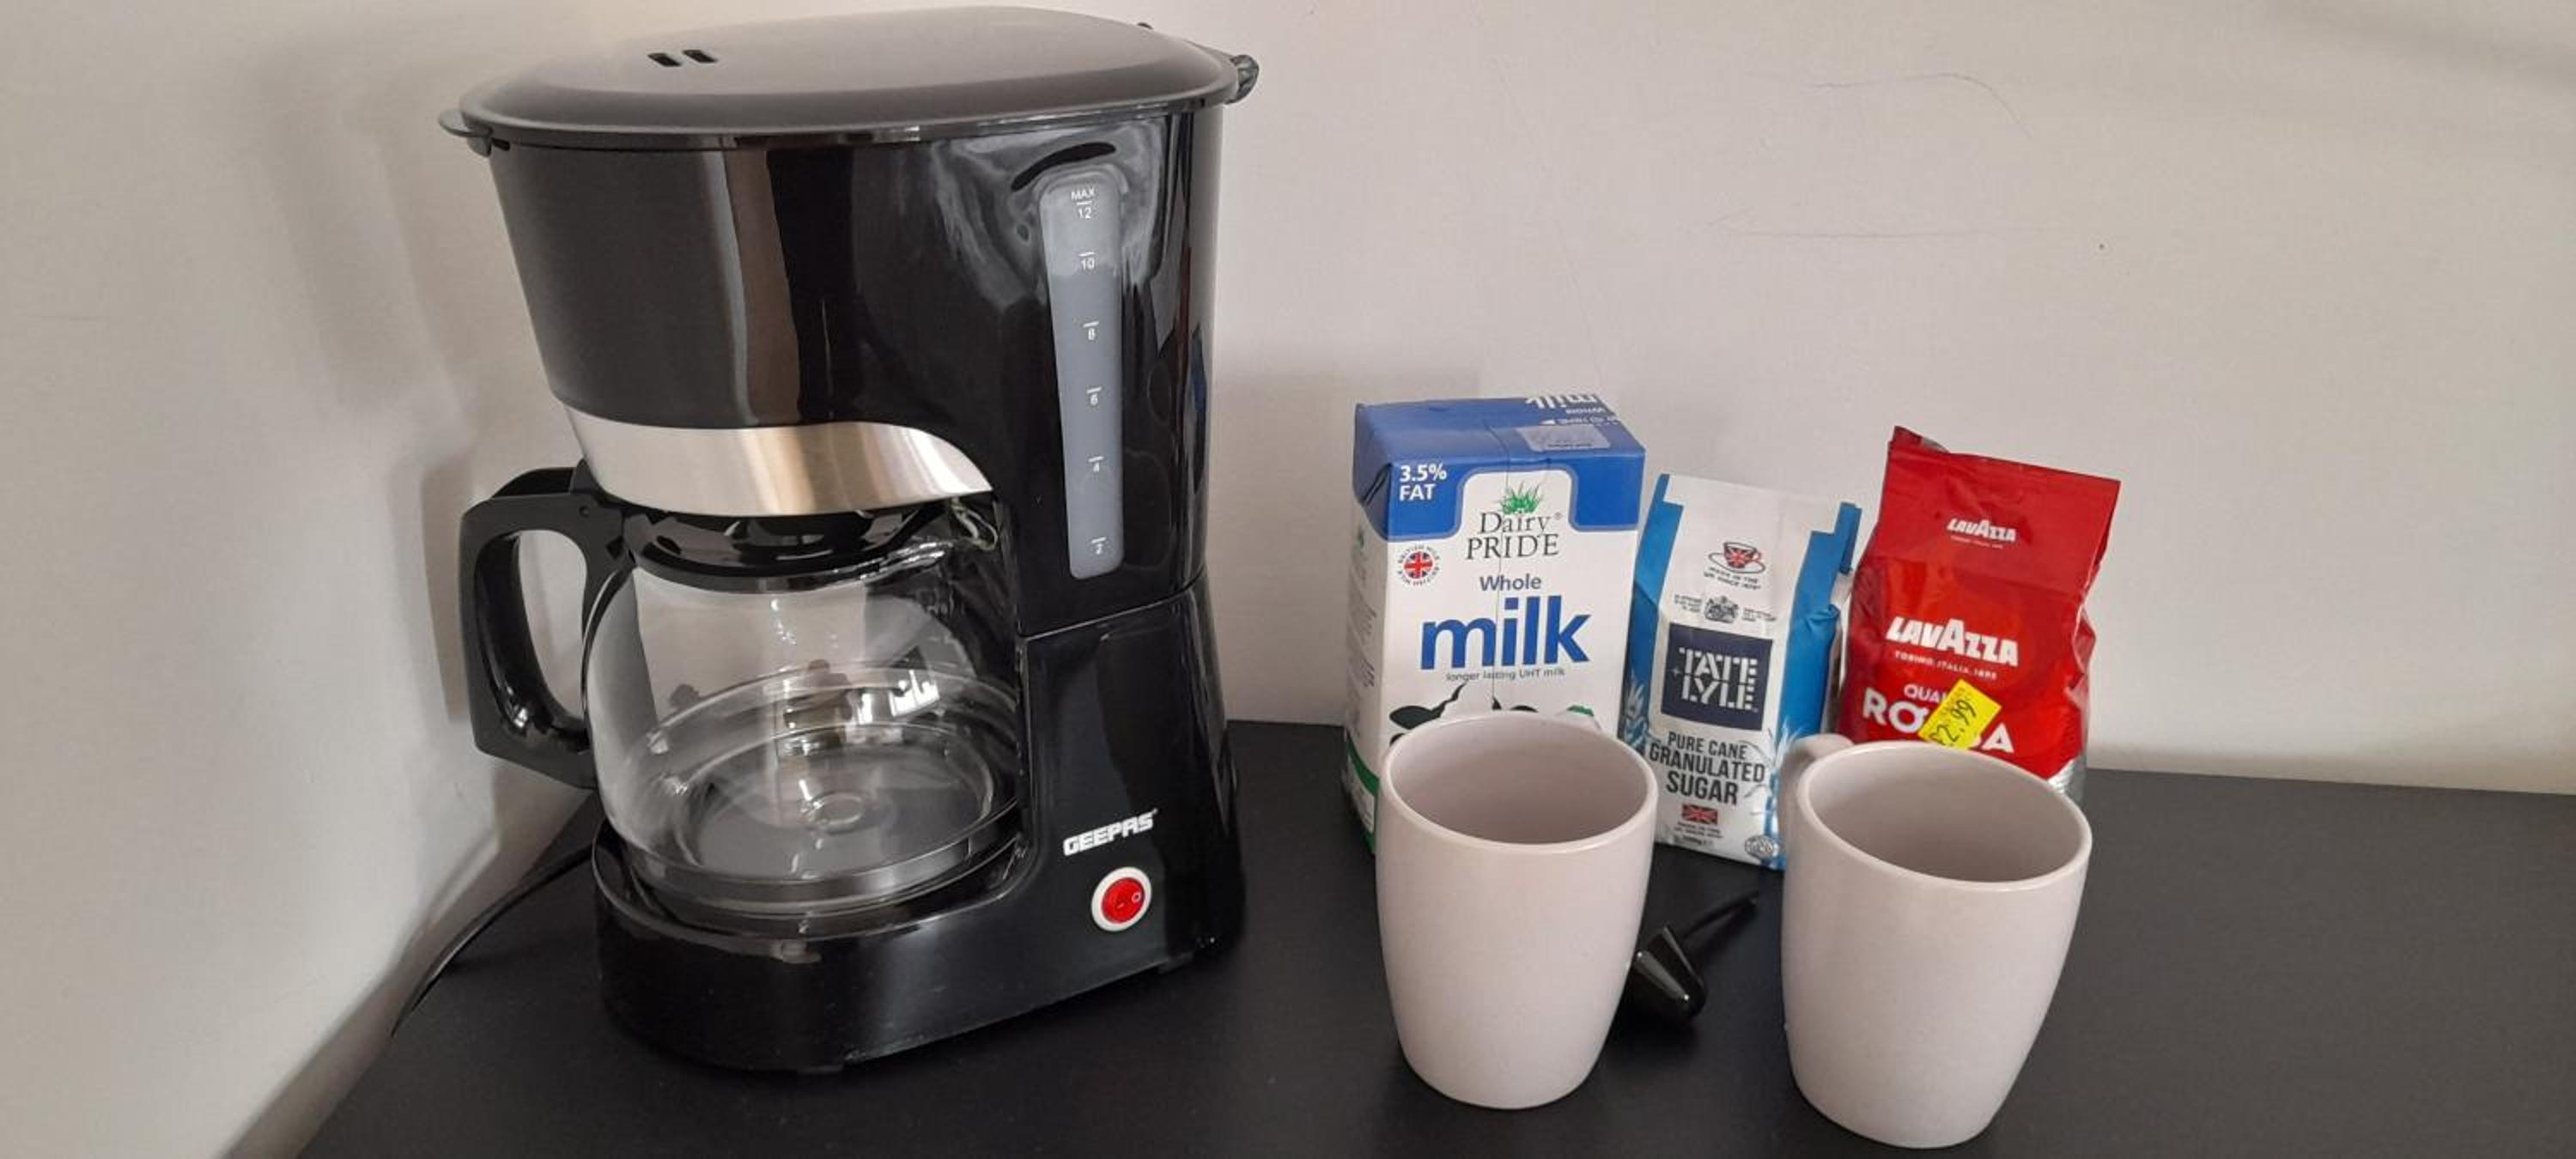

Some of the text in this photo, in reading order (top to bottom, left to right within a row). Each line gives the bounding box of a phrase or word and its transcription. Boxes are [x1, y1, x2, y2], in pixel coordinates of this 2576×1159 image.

[1071, 188, 1095, 201] MAX
[1078, 207, 1091, 219] 12
[1081, 258, 1095, 270] 10
[1088, 328, 1097, 341] 8
[1090, 394, 1098, 406] 6
[1399, 463, 1447, 482] 3.5%
[1399, 483, 1436, 501] FAT
[1479, 510, 1552, 537] Dairy
[1947, 519, 2016, 543] LAVAZZA
[1465, 533, 1559, 560] PRIDE
[1479, 573, 1542, 591] Whole
[1421, 595, 1592, 671] milk
[1885, 616, 2020, 668] LAVAZZA
[1446, 667, 1565, 682] longer lasting UHT milk
[1679, 646, 1758, 685] TATE
[1681, 675, 1757, 711] LYLE
[1668, 731, 1748, 761] PURE CANE
[1649, 742, 1765, 783] GRANULATED
[1667, 770, 1739, 804] SUGAR
[1063, 811, 1153, 856] GEEPAS
